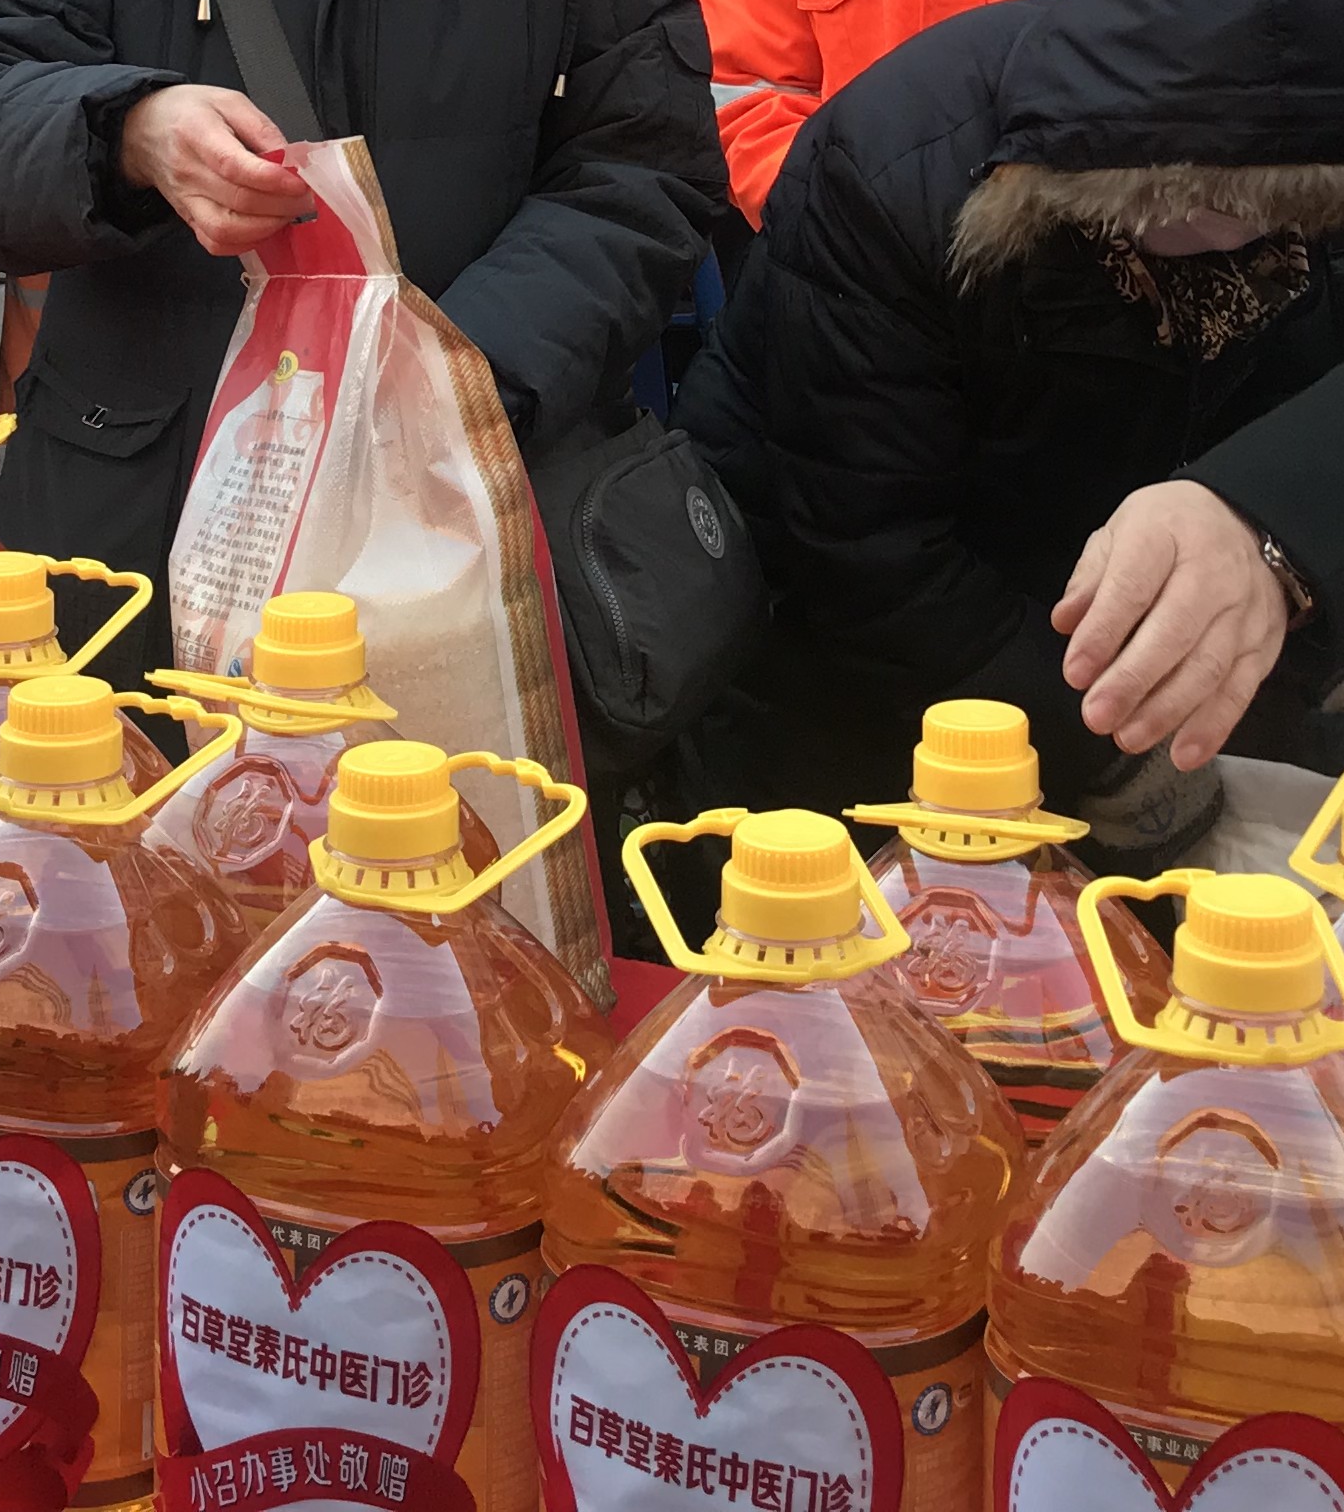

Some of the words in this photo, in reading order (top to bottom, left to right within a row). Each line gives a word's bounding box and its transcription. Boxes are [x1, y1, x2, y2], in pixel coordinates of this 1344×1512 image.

[180, 1292, 434, 1409] 百草堂秦氏中医门诊
[190, 1440, 410, 1512] 小召办事处敬赠
[569, 1393, 855, 1512] 百草堂秦氏中医门诊
